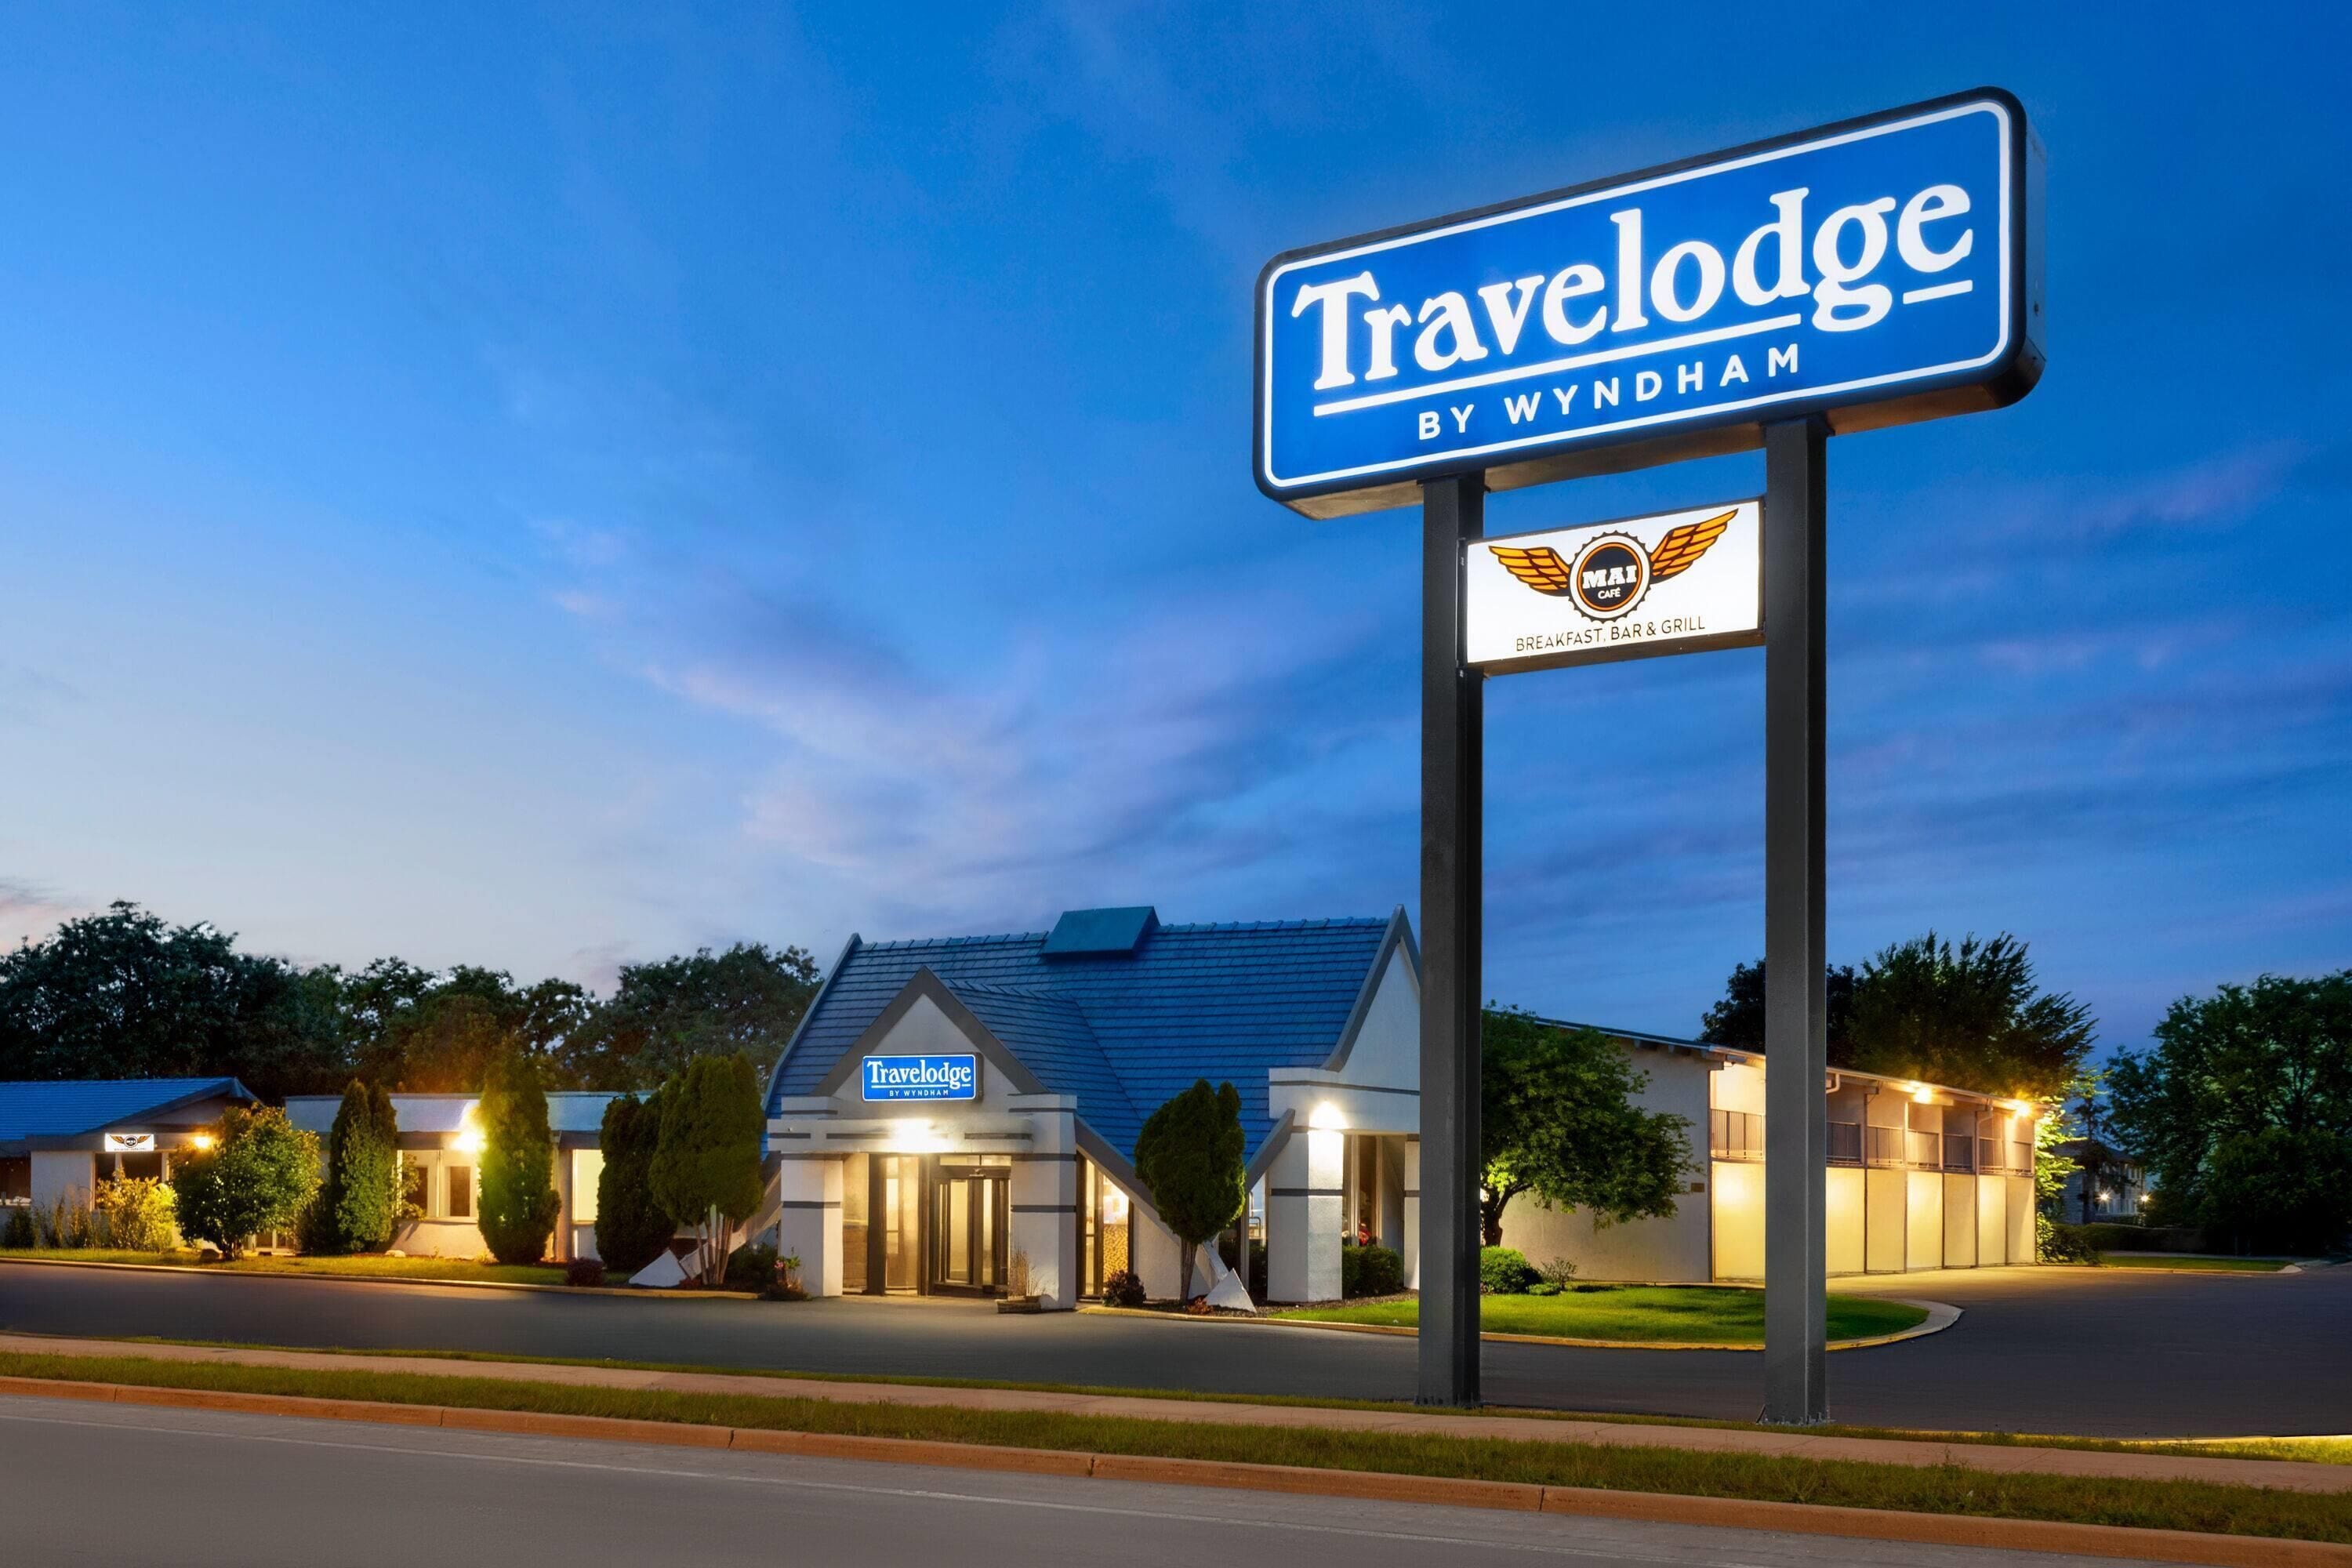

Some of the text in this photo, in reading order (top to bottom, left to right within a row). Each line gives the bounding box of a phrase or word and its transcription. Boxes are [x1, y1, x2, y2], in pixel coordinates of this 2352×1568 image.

[1290, 184, 1974, 391] Travelodge
[1417, 343, 1798, 441] BY WYNDHAM
[1582, 564, 1638, 590] MAI
[1597, 586, 1621, 600] CAFÉ
[1515, 615, 1706, 652] BREAKFAST, BAR & GRILL
[866, 1059, 972, 1090] Travelodge
